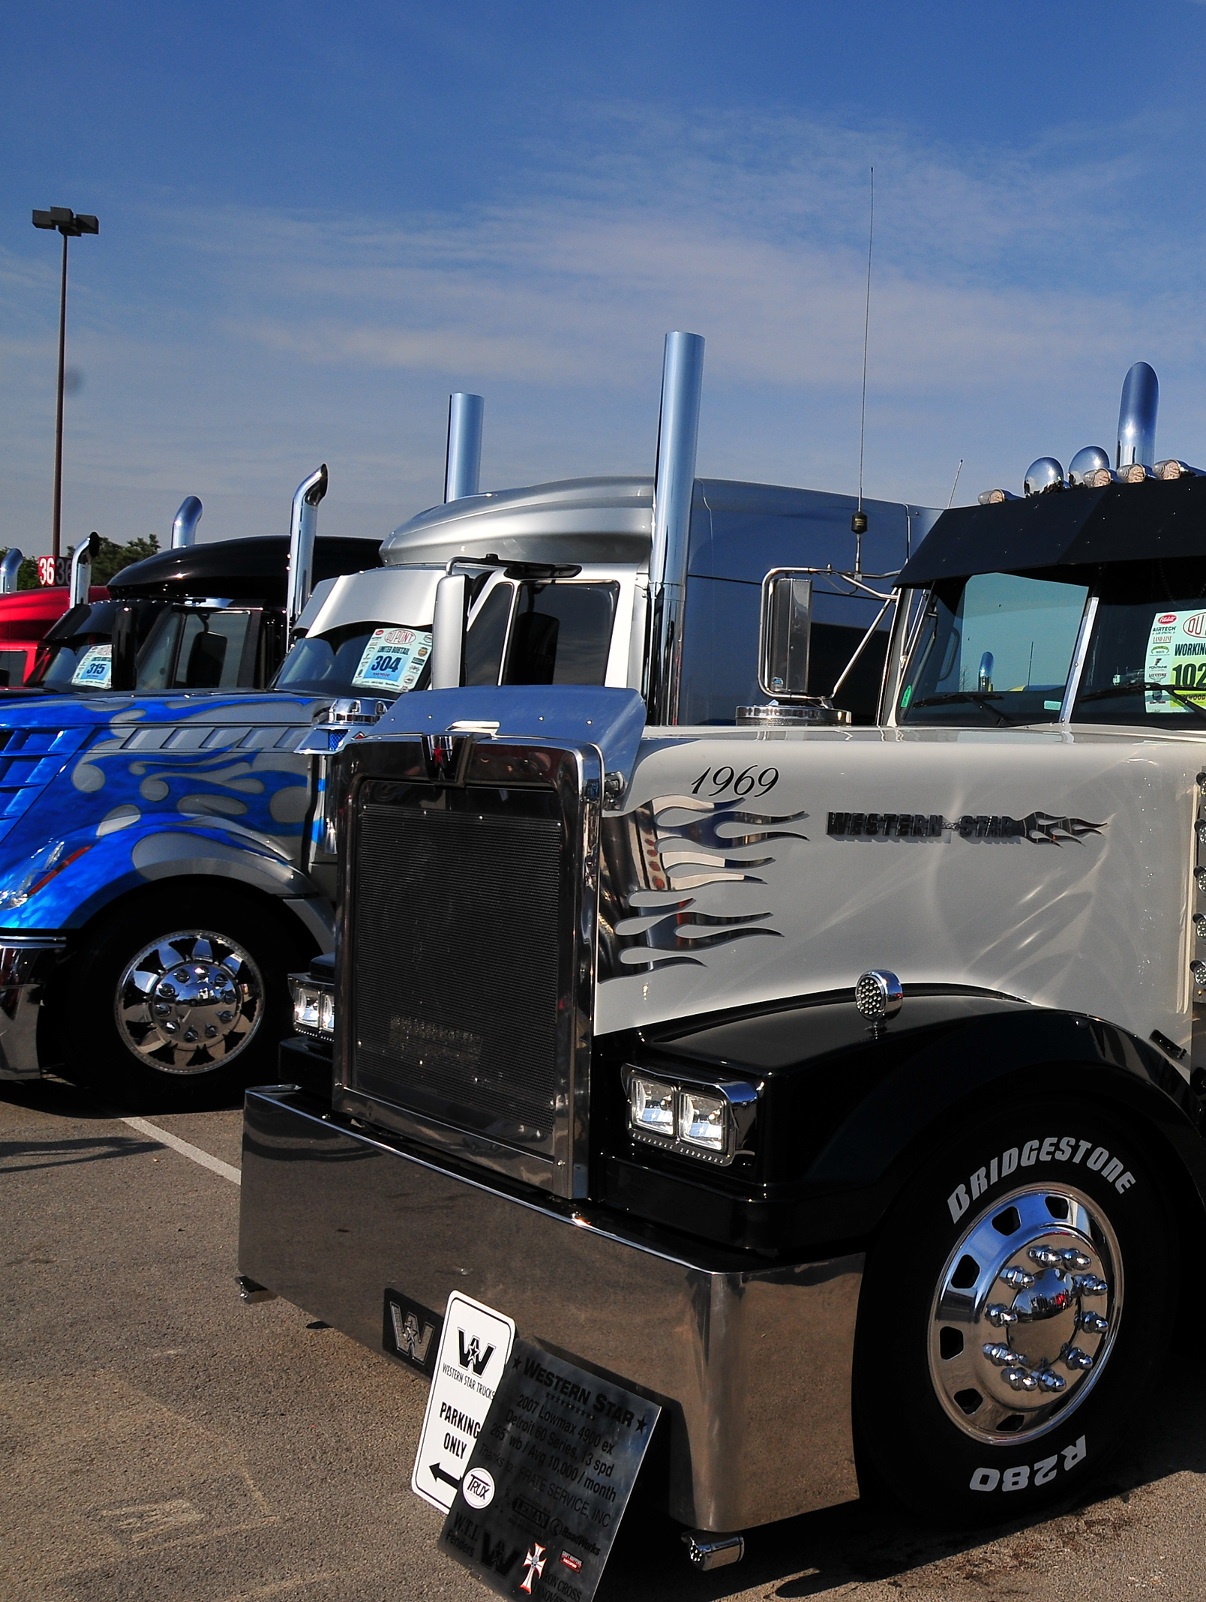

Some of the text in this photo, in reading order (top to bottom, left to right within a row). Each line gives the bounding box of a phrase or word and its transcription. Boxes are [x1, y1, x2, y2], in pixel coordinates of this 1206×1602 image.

[40, 557, 55, 585] 36
[86, 663, 107, 674] 315
[371, 655, 402, 672] 304
[691, 764, 779, 797] 1969
[826, 811, 1013, 838] WESTERN STAR
[946, 1136, 1137, 1224] BRIDGESTONE
[442, 1362, 496, 1400] WESTERN STAR TRUCKS
[439, 1402, 481, 1439] PARKING
[517, 1394, 615, 1455] 2007 Lowmax 4900 ex
[443, 1432, 467, 1460] ONLY
[505, 1409, 536, 1436] Detroit
[535, 1426, 546, 1441] 60
[582, 1450, 594, 1466] 13
[593, 1459, 615, 1478] spd
[509, 1435, 523, 1451] wb
[528, 1444, 546, 1467] Avg
[583, 1475, 617, 1503] month
[969, 1434, 1088, 1492] R280
[466, 1473, 490, 1500] TRUX
[479, 1442, 504, 1467] Thanks
[591, 1508, 611, 1528] INC
[454, 1511, 479, 1542] W.T.I.
[561, 1526, 601, 1556] RoadWorks
[446, 1529, 475, 1557] Fenders
